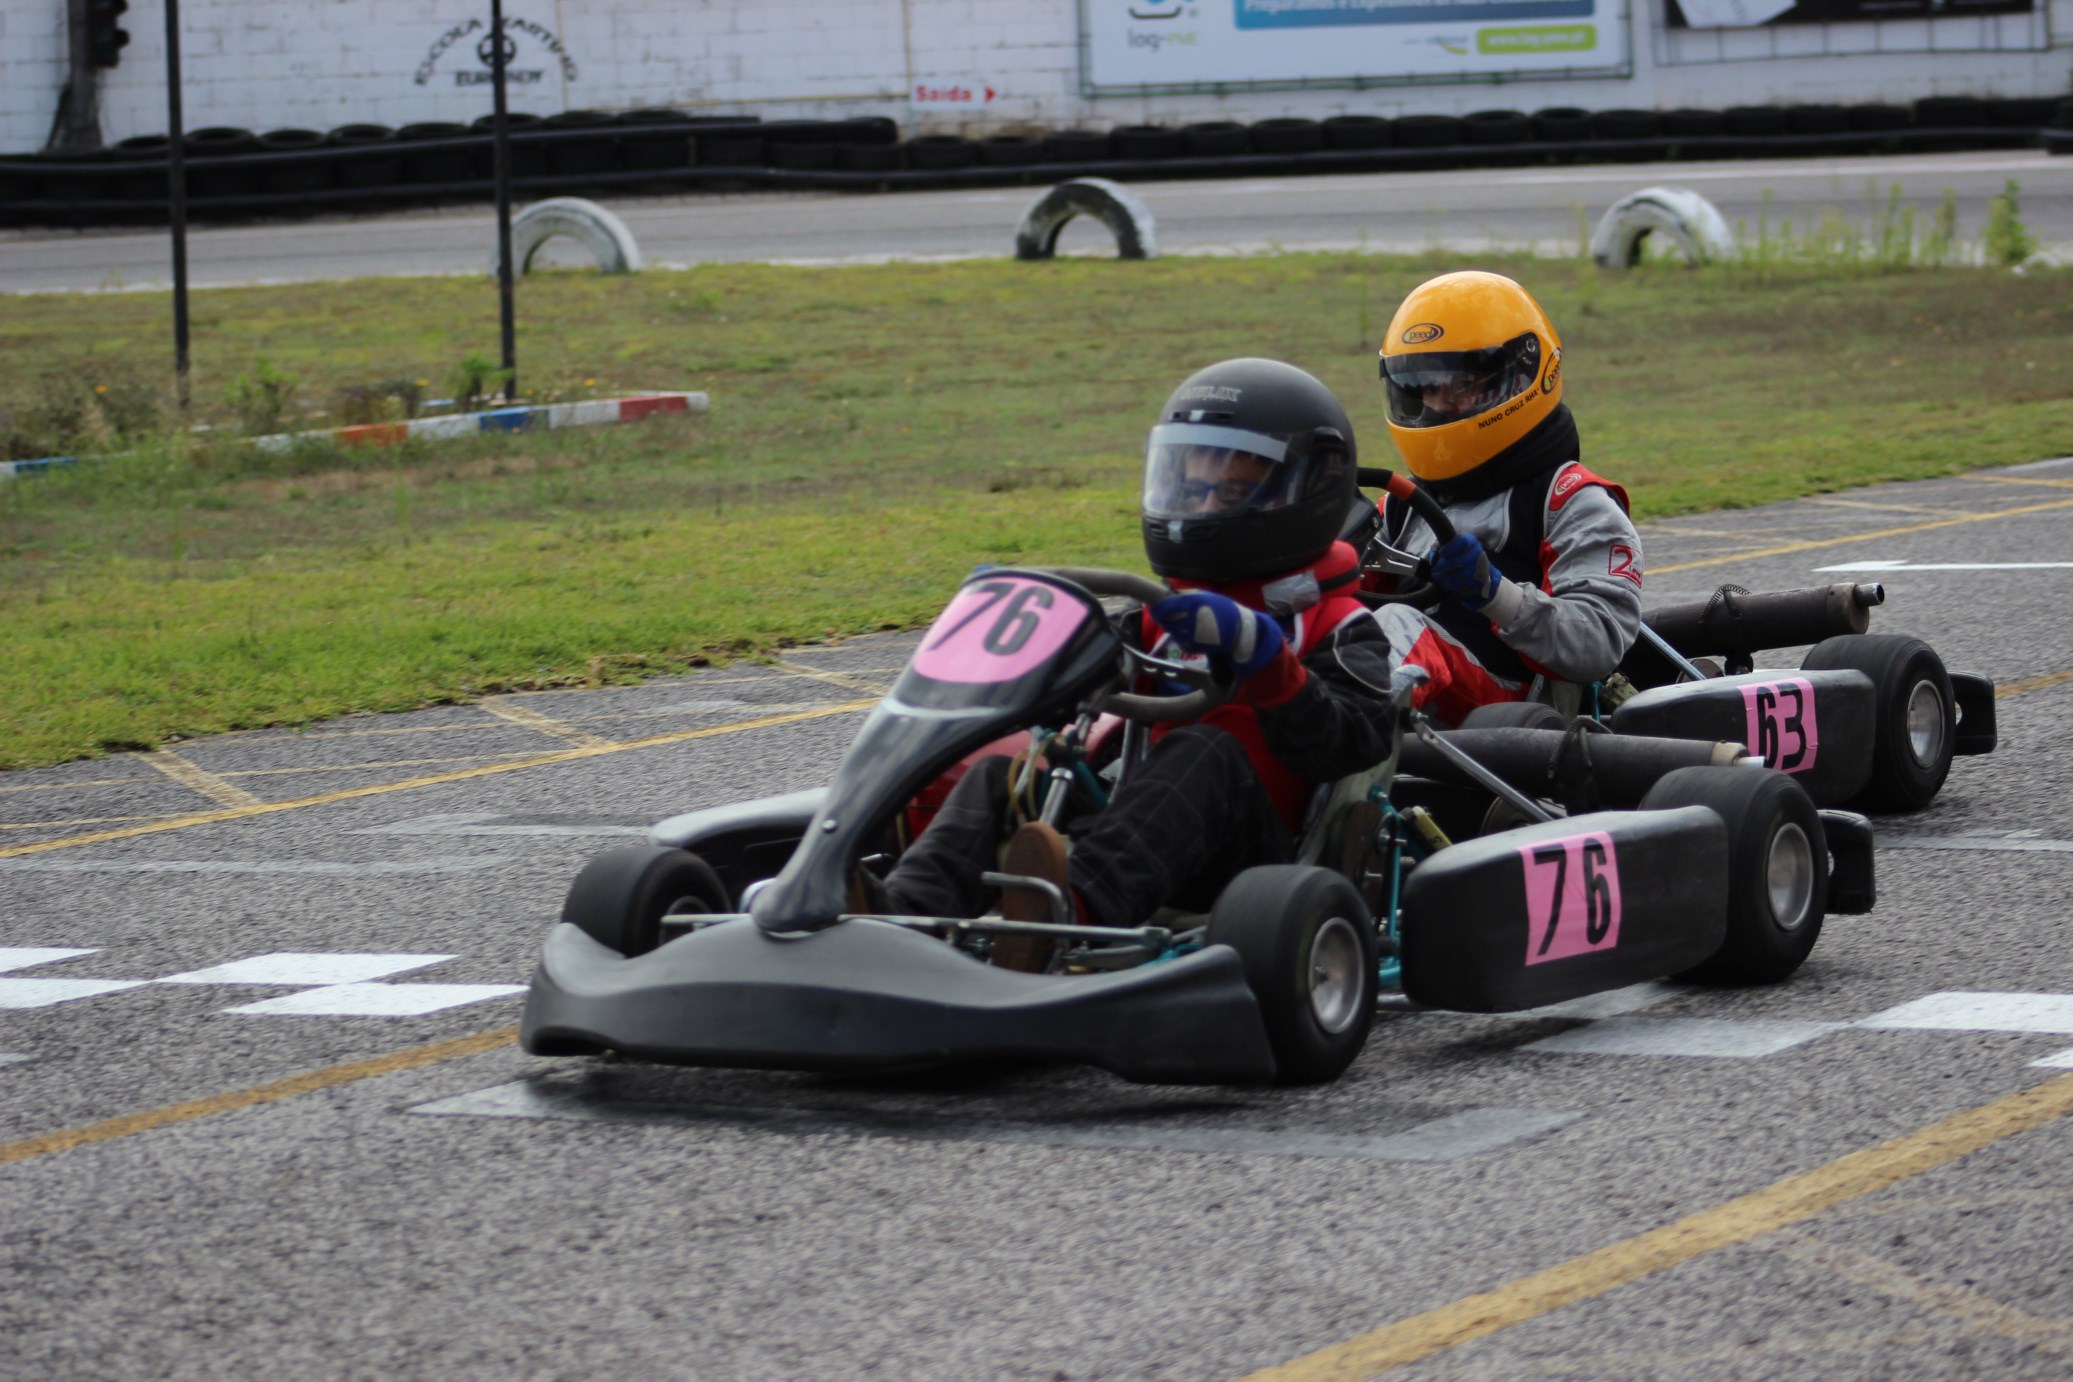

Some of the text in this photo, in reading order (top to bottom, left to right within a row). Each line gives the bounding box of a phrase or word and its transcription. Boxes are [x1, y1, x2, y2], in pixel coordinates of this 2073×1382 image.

[1477, 412, 1503, 430] NUNO
[1504, 401, 1525, 417] CRUZ
[928, 582, 1056, 657] 76
[1756, 682, 1807, 770] 63
[1531, 837, 1612, 957] 76
